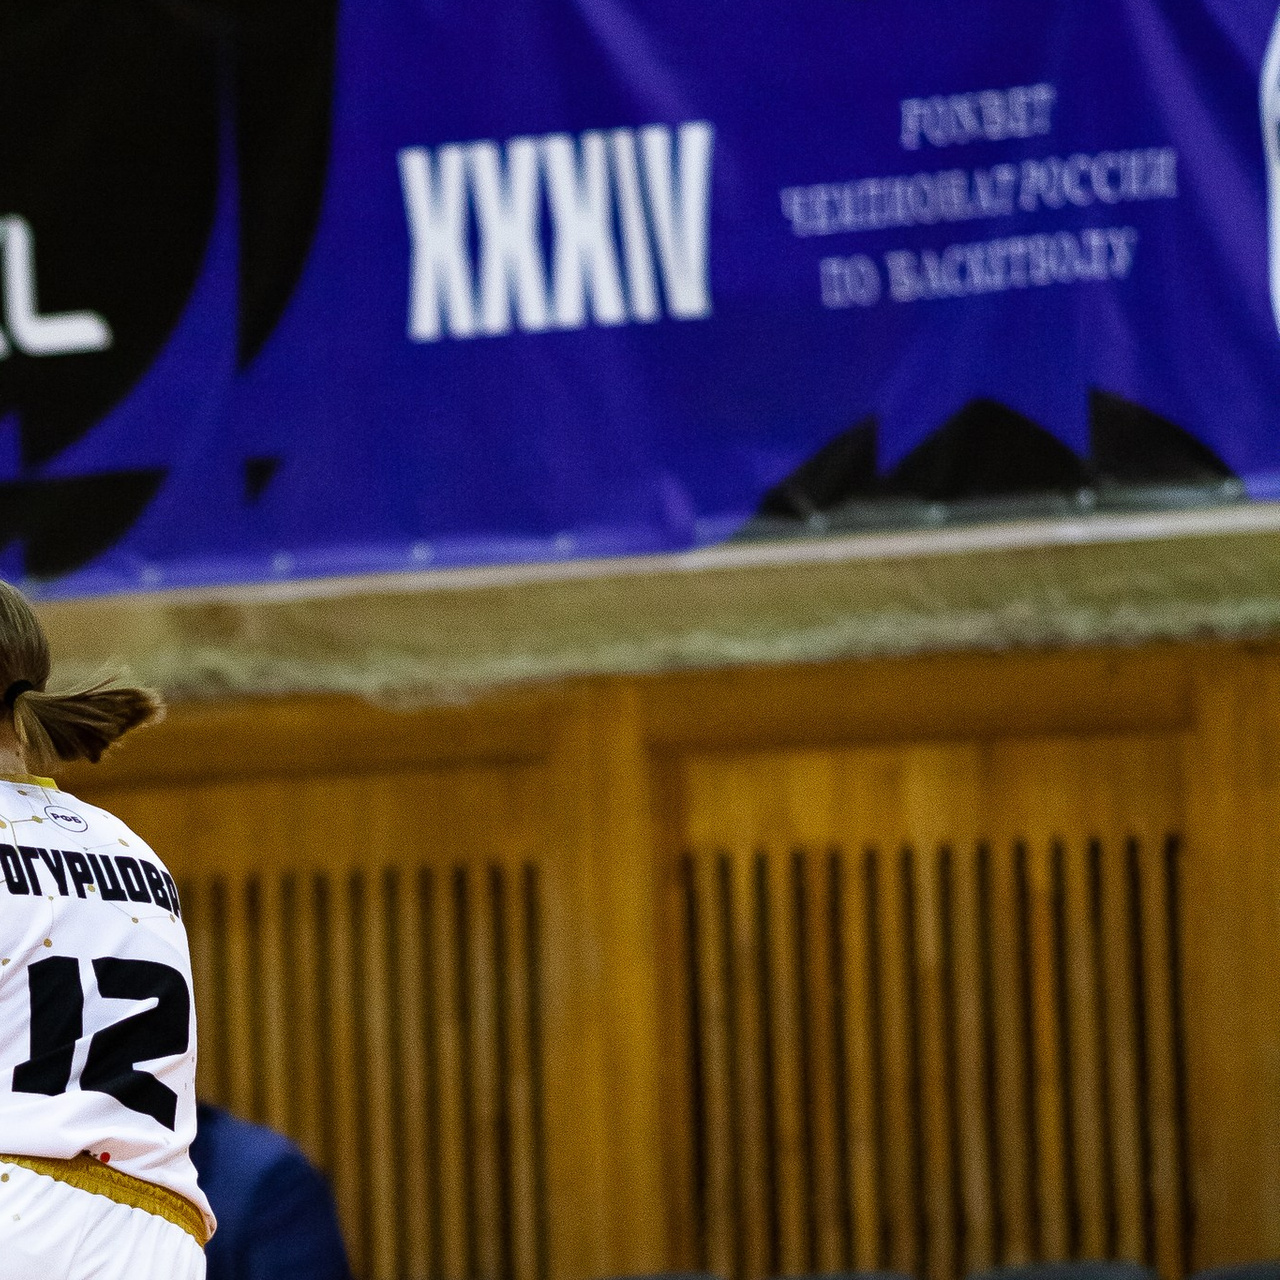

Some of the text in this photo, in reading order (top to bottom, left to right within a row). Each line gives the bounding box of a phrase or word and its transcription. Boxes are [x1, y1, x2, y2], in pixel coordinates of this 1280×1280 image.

[397, 120, 714, 342] XXXIV
[50, 812, 82, 825] РФБ
[12, 956, 191, 1132] 12
